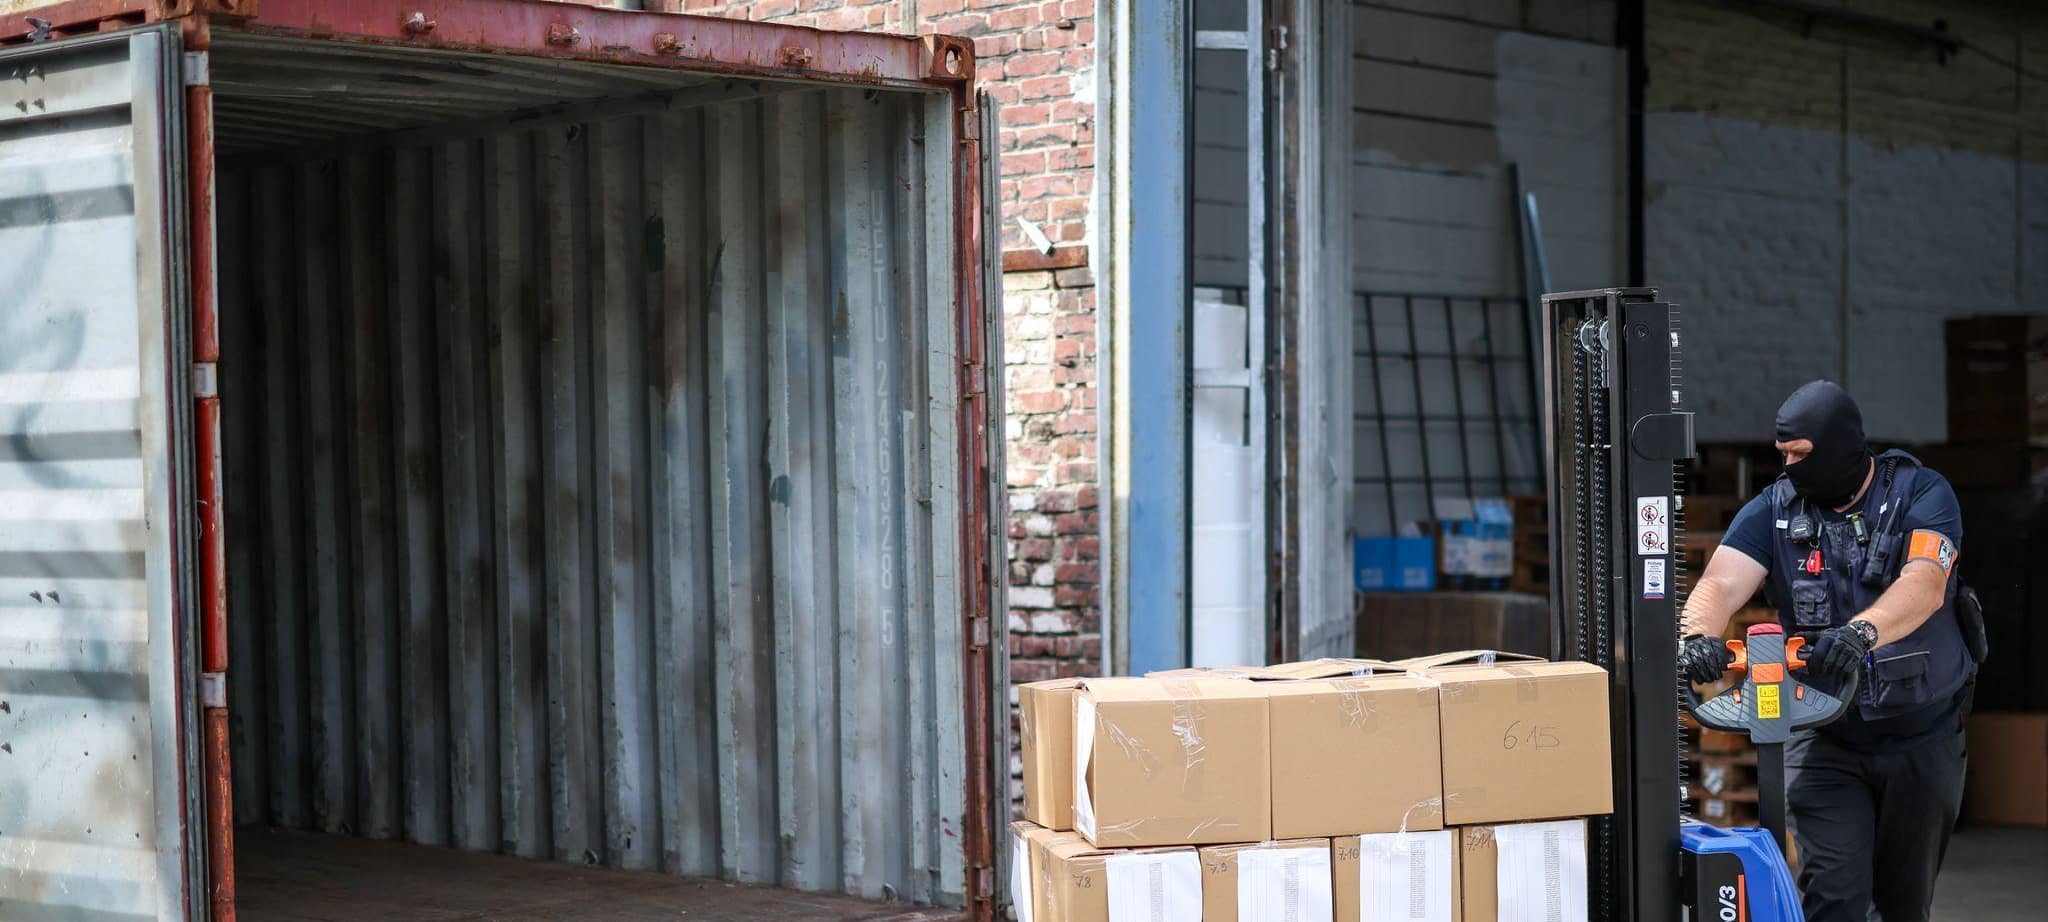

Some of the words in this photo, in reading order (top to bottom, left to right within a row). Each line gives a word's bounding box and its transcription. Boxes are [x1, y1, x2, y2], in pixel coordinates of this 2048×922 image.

[877, 360, 893, 590] 246328
[1797, 559, 1831, 570] ZL
[882, 608, 894, 646] 5
[1719, 885, 1737, 922] 0/3
